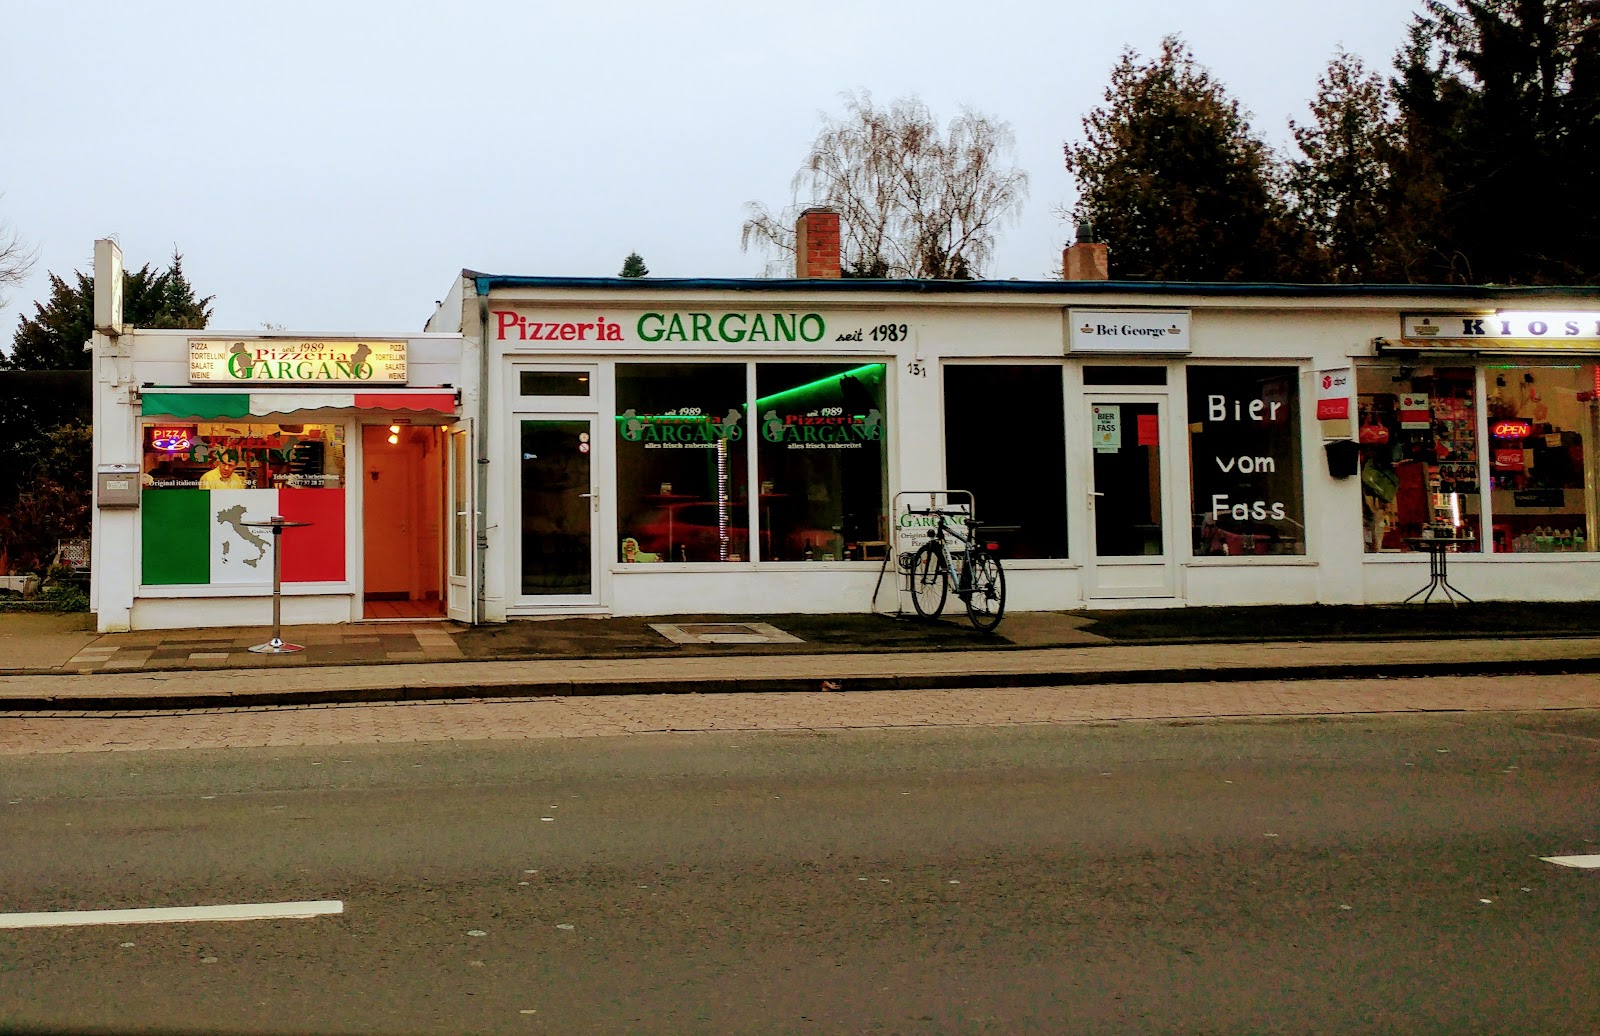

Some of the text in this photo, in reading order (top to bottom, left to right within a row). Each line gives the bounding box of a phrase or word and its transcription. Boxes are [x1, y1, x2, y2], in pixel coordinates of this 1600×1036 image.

[492, 311, 908, 342] Pizzeria GARGANO seit 1989
[1097, 325, 1166, 339] Bei George
[1463, 318, 1600, 336] KIOS
[255, 348, 348, 360] Pizzeria
[299, 343, 324, 352] 1989
[228, 352, 373, 379] GARGANO
[907, 363, 926, 378] 131
[1334, 377, 1347, 387] dpd
[679, 407, 702, 416] 1989
[821, 407, 843, 416] 1989
[1208, 394, 1281, 421] Bier
[785, 414, 863, 425] Pizzeria
[153, 429, 188, 439] PIZZA
[620, 418, 743, 442] GARGANO
[762, 418, 885, 442] GARGANO
[1097, 424, 1116, 432] FASS
[1495, 425, 1527, 435] OPEN
[1215, 455, 1276, 474] vom
[148, 480, 175, 488] Original
[1211, 493, 1286, 521] Fass
